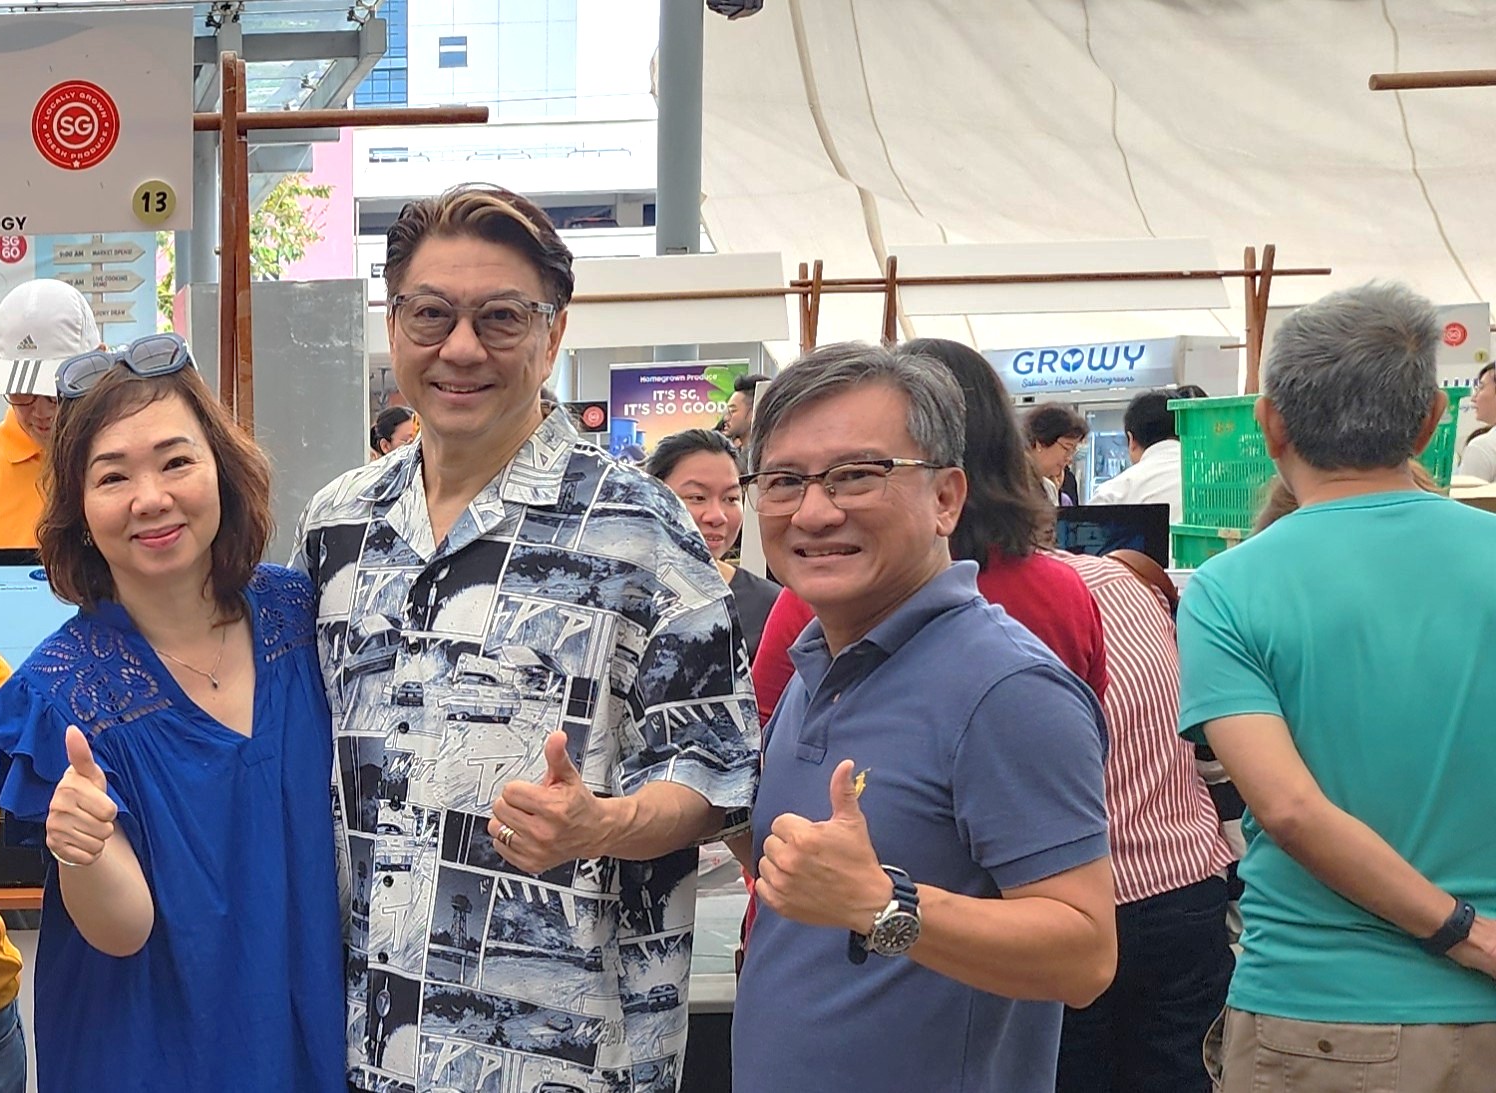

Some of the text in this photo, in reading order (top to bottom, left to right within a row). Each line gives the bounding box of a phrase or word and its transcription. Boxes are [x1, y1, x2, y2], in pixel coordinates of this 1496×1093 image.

[44, 92, 108, 121] LOCALLY GROWN
[59, 116, 93, 136] SG
[44, 132, 108, 159] FRESH PRODUCE
[140, 191, 168, 213] 13
[2, 236, 19, 246] SG
[2, 247, 19, 259] 60
[1012, 345, 1146, 375] GROWY
[640, 373, 718, 384] Homegrown Produce
[1055, 377, 1079, 386] Herbs
[653, 389, 700, 401] IT'S SG,
[624, 403, 651, 416] IT'S
[655, 402, 677, 415] SO
